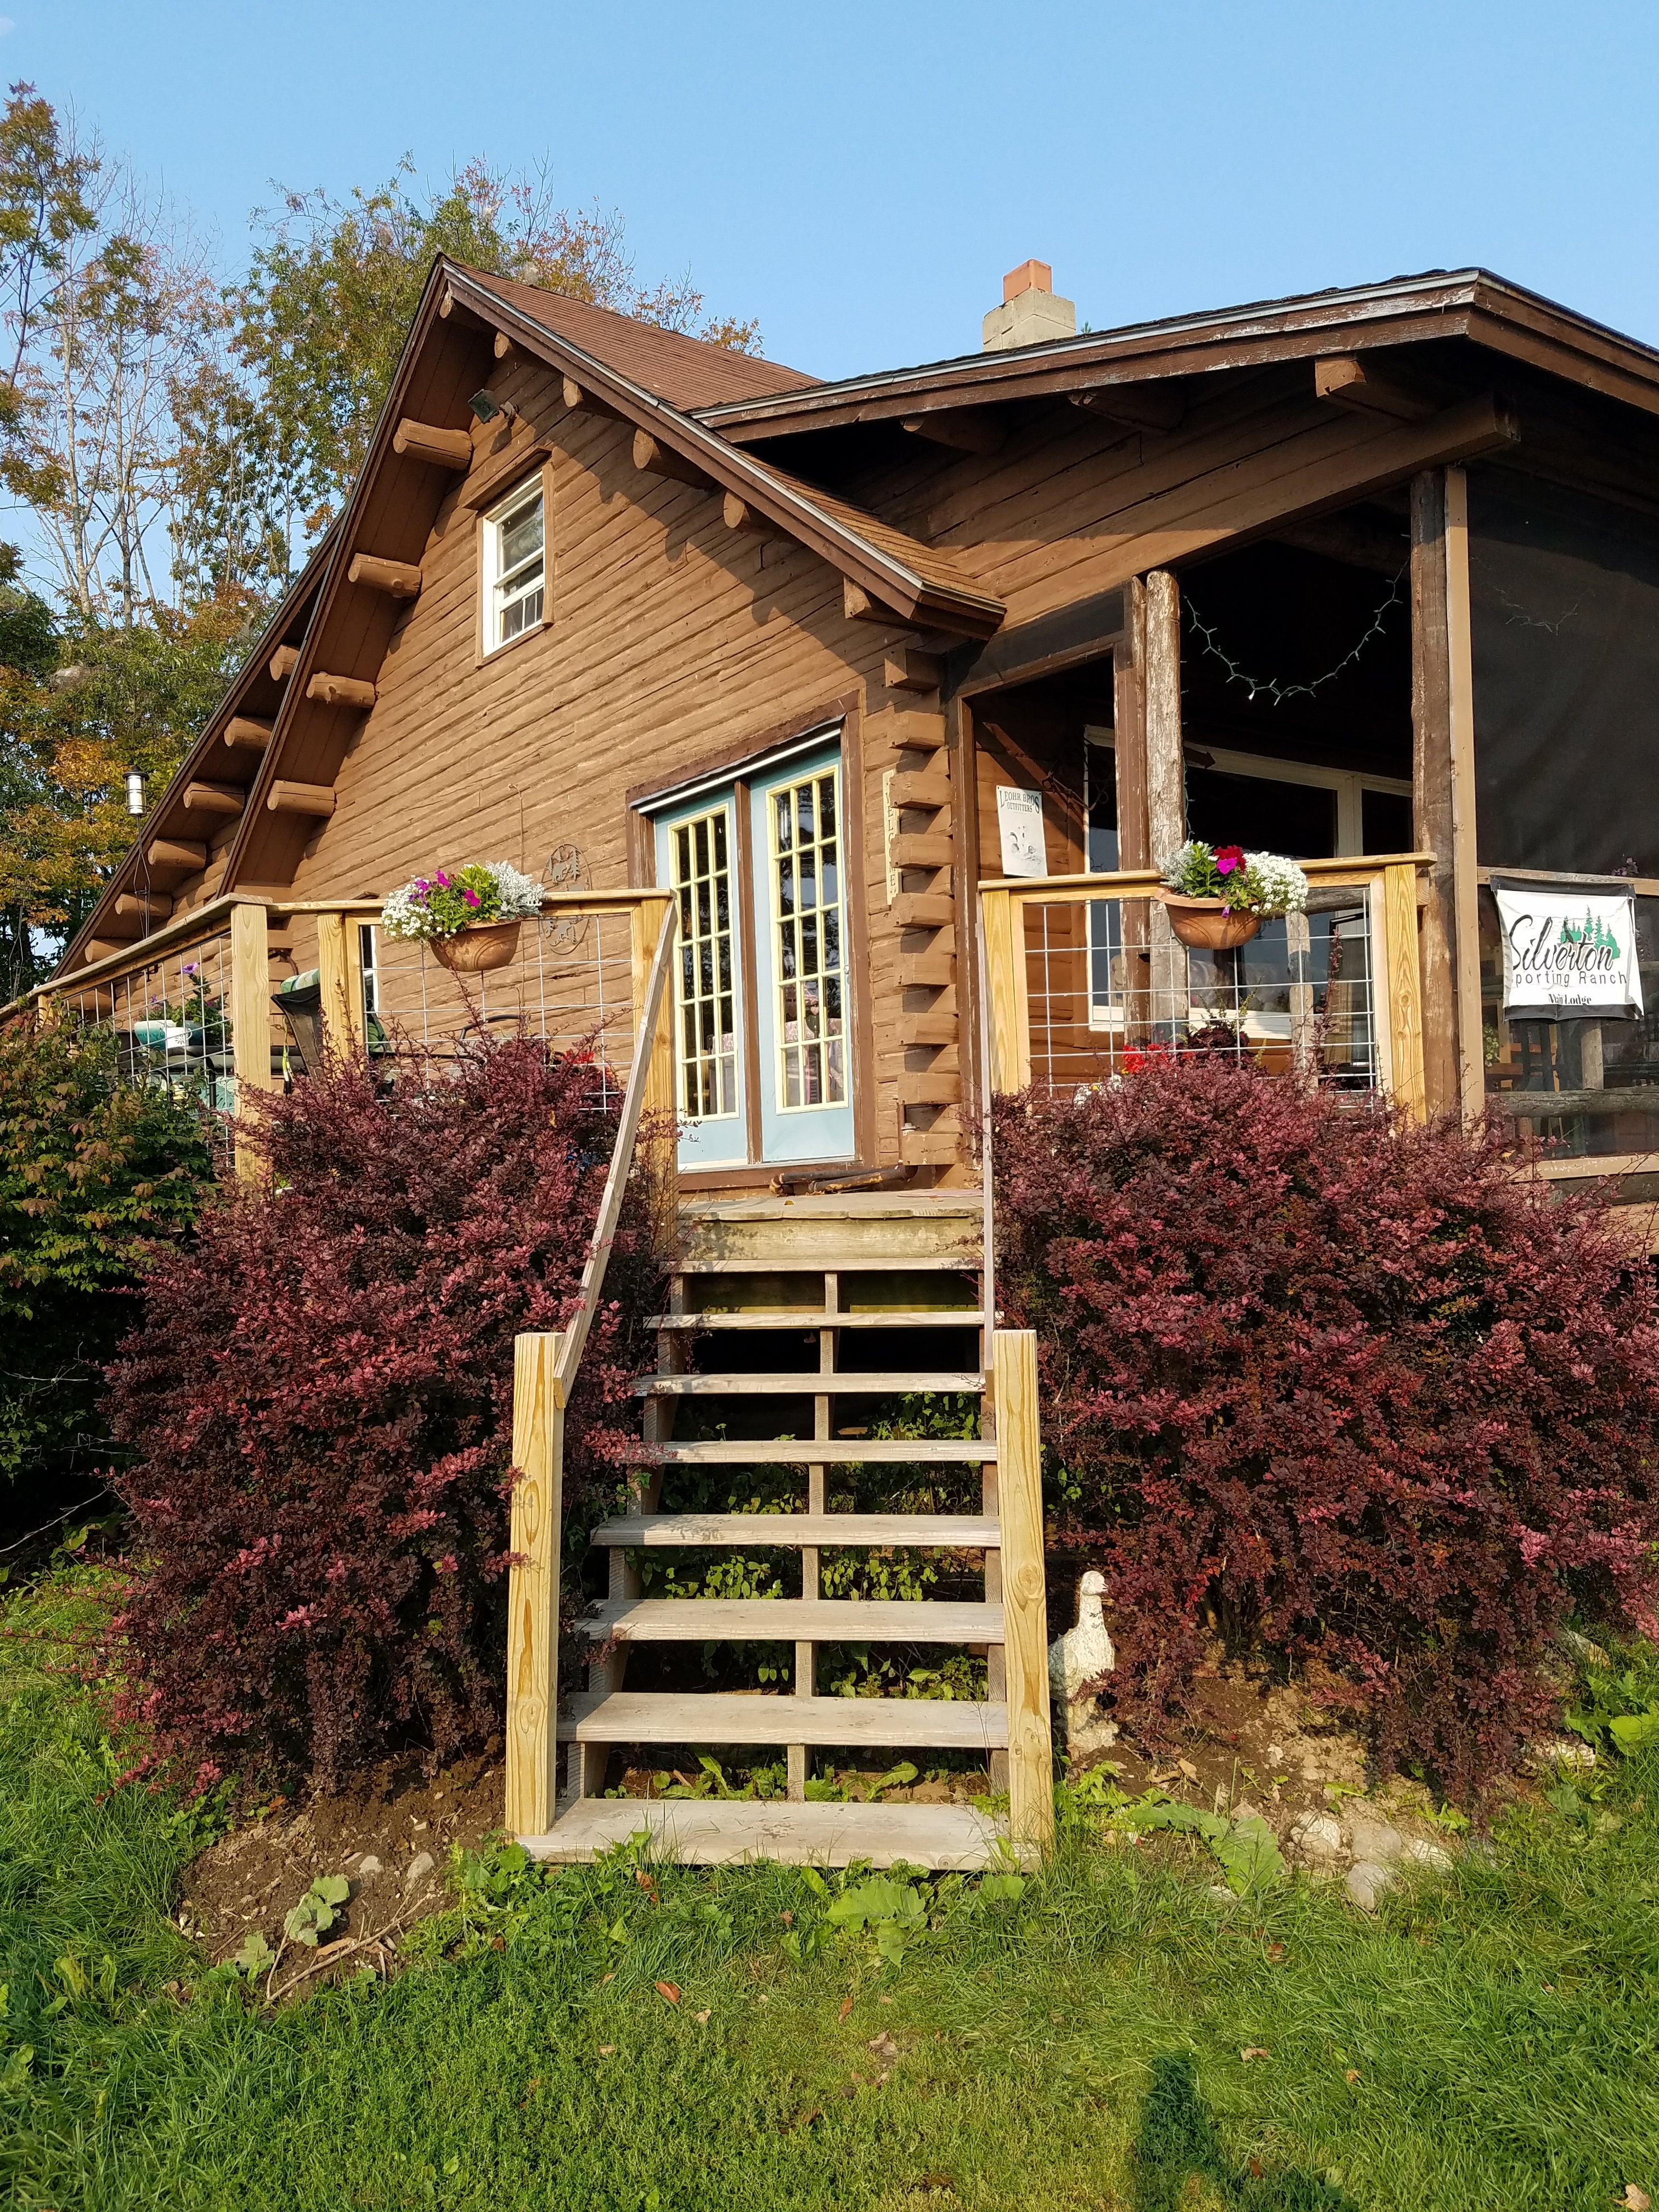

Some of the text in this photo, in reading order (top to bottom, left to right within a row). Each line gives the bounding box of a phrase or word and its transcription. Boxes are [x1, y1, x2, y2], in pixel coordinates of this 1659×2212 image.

[1000, 791, 1021, 808] LEOHR
[1007, 802, 1032, 812] OUTFITTERS
[1509, 915, 1614, 970] Silverton
[1516, 970, 1627, 988] porting Ranch
[1565, 994, 1592, 1005] Lodge
